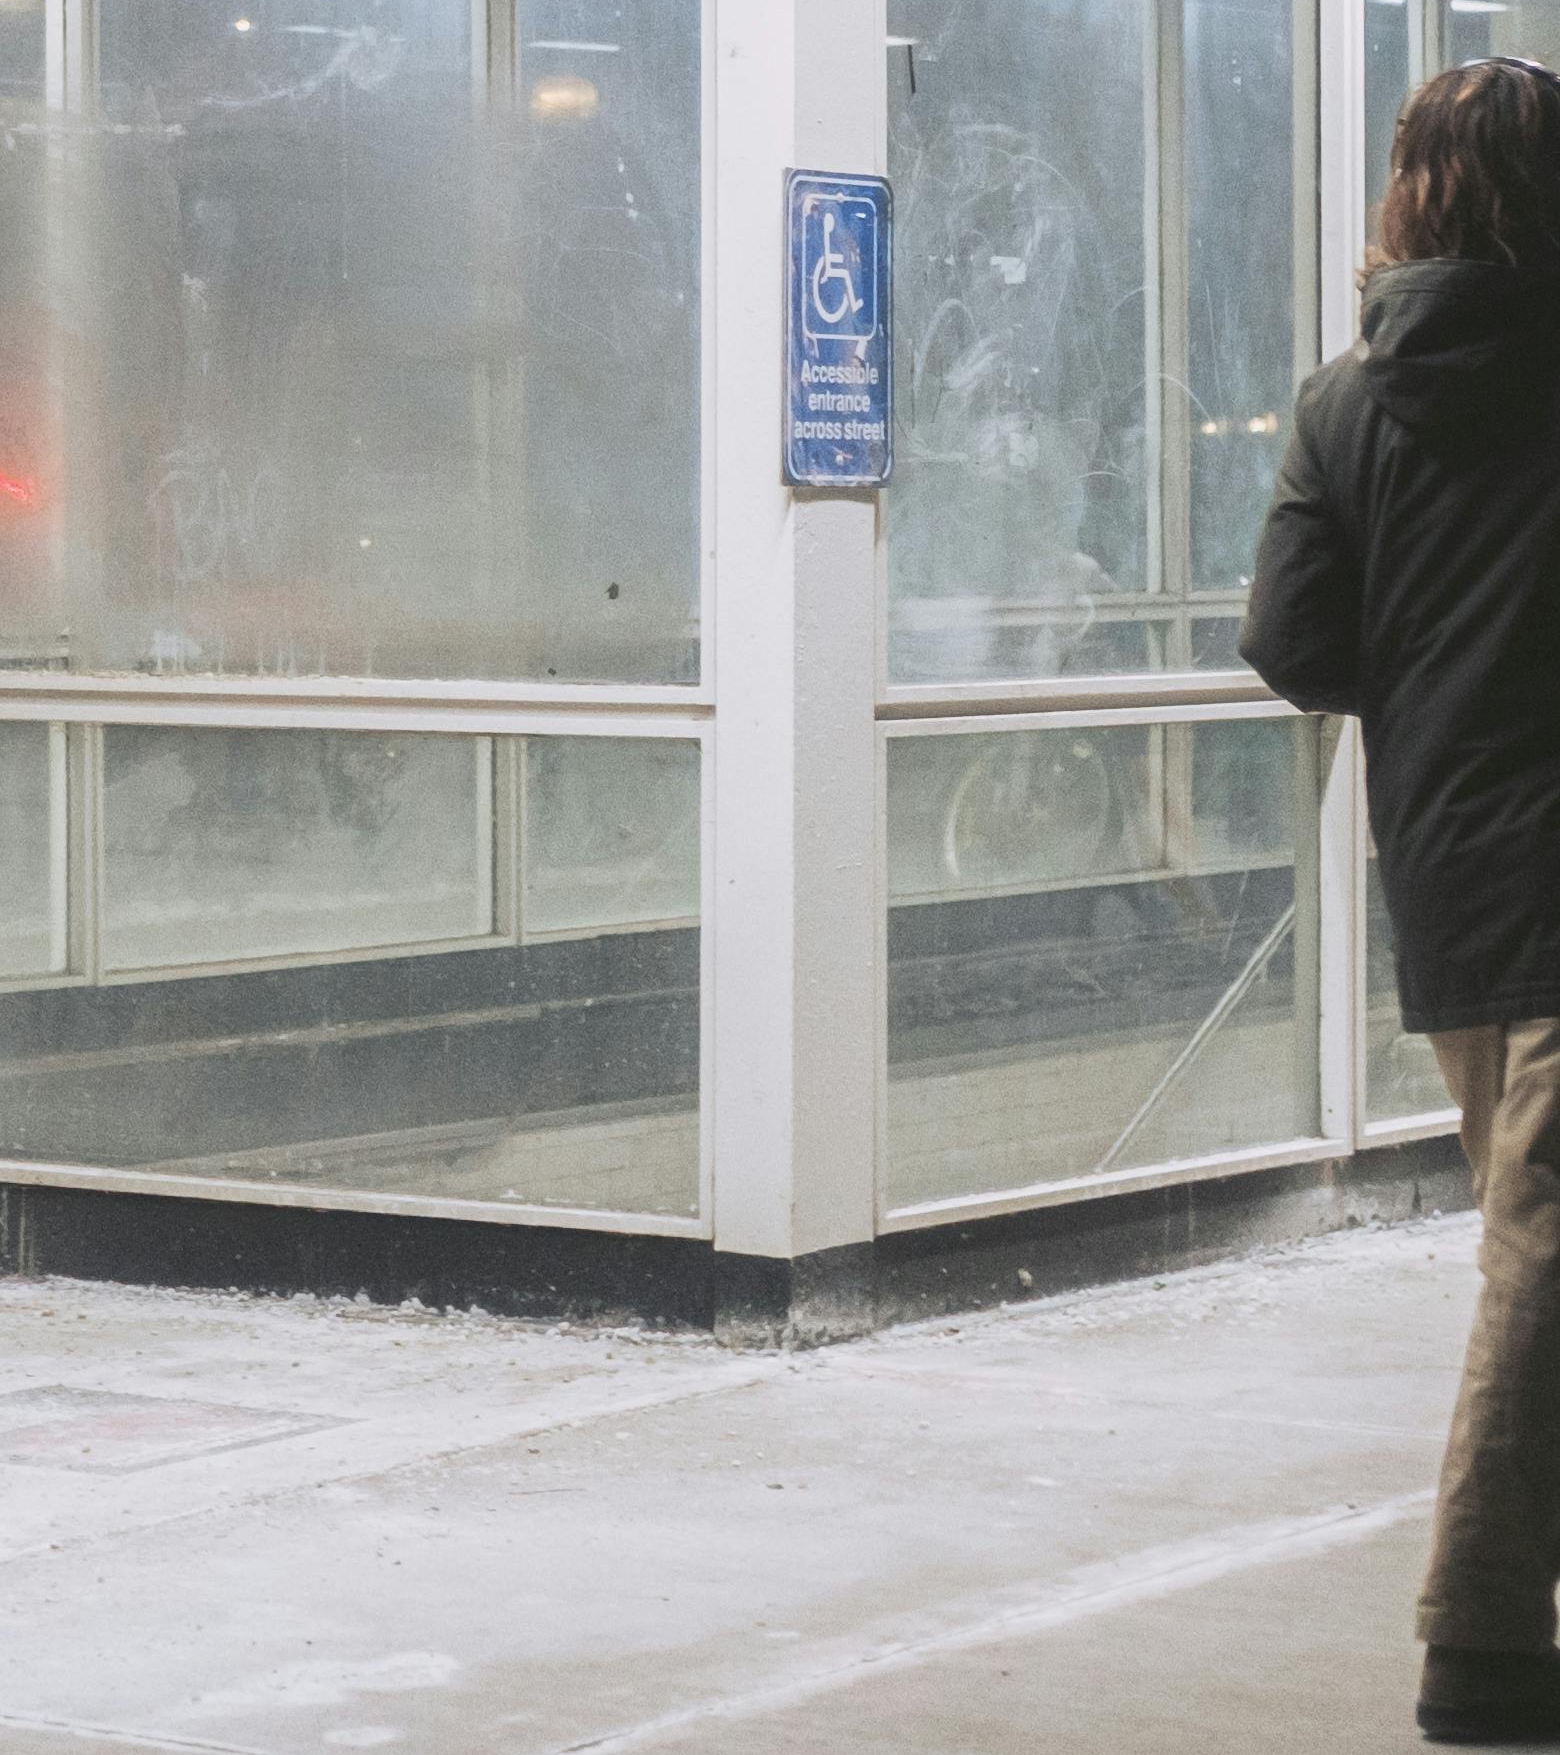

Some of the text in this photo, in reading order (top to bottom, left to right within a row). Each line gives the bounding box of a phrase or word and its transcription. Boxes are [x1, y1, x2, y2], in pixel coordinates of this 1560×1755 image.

[801, 360, 878, 384] Accessible
[809, 391, 871, 412] entrance
[794, 420, 885, 441] across street
